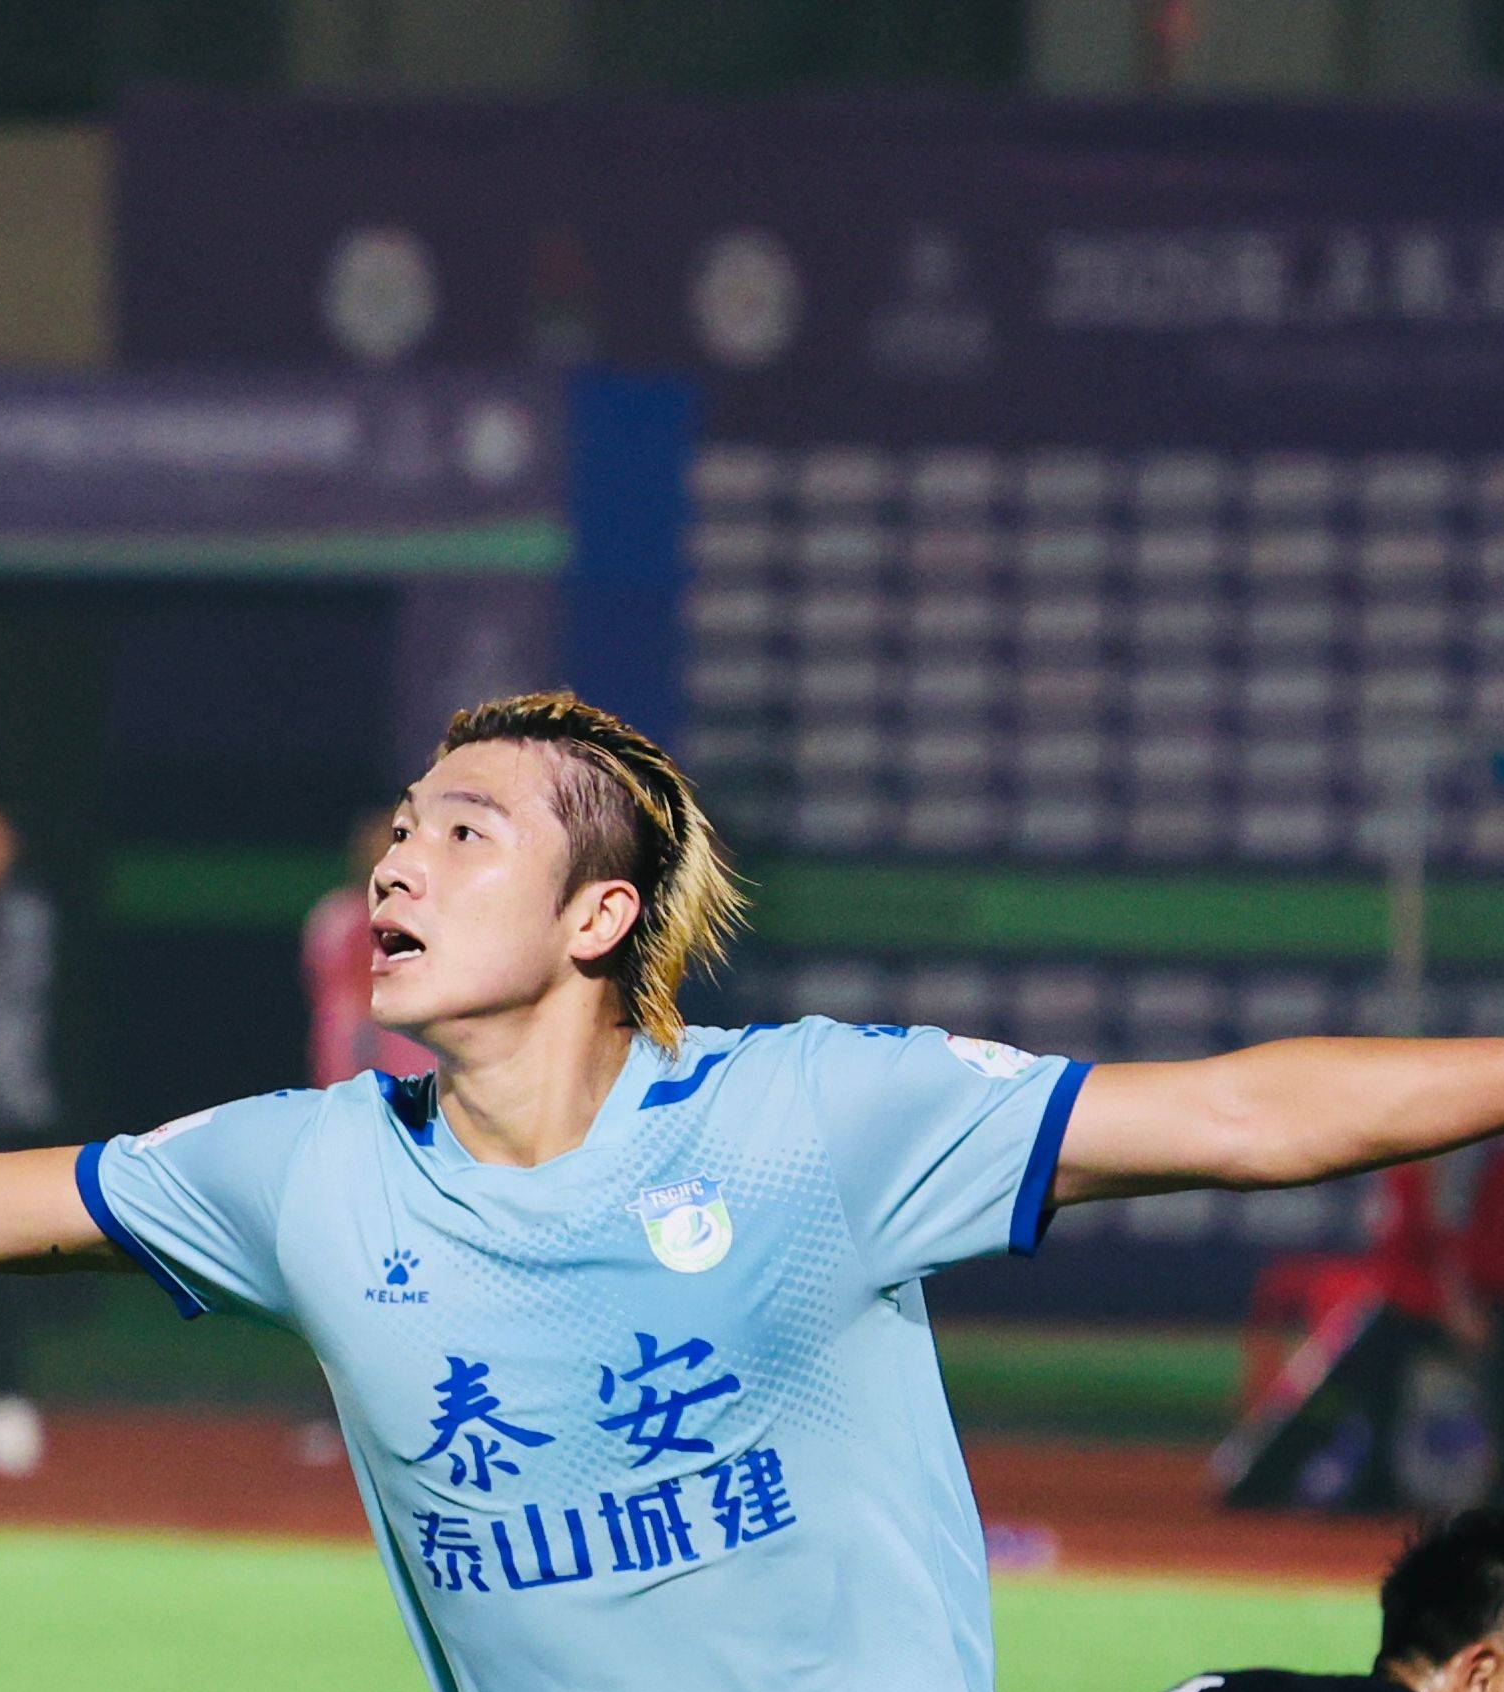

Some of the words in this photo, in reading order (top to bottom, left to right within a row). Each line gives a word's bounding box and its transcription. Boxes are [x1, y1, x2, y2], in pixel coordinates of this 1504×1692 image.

[364, 1288, 430, 1304] KELME
[414, 1332, 742, 1492] 泰安
[412, 1447, 797, 1593] 泰山城建
